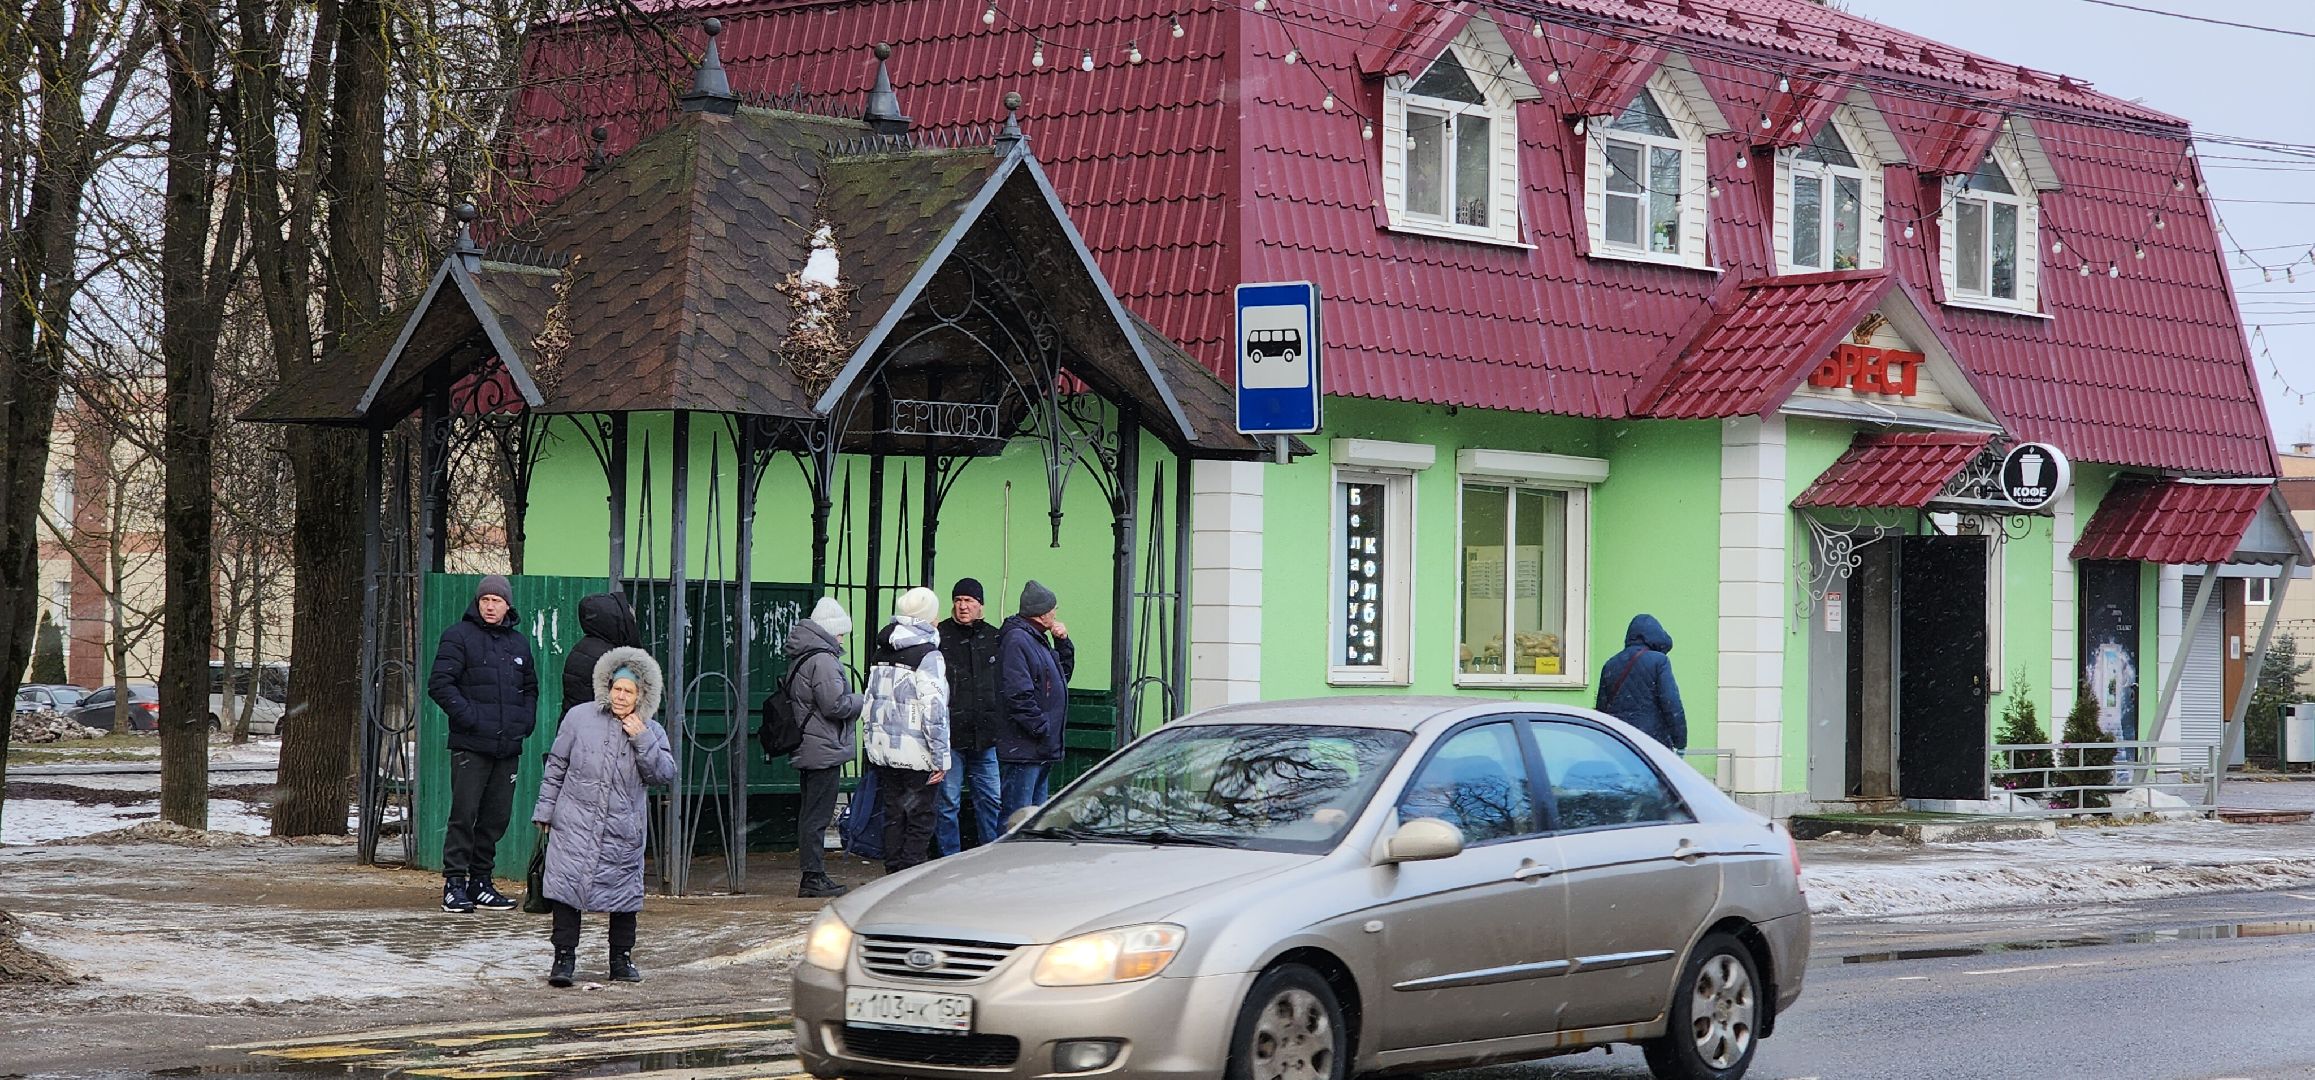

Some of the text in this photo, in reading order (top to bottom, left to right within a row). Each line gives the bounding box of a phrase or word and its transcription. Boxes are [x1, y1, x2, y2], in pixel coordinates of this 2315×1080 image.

[1808, 343, 1926, 397] БРЕСТ
[896, 401, 995, 437] ЕРШОВО
[2013, 486, 2048, 497] КОФЕ
[1348, 488, 1361, 659] Беларусь
